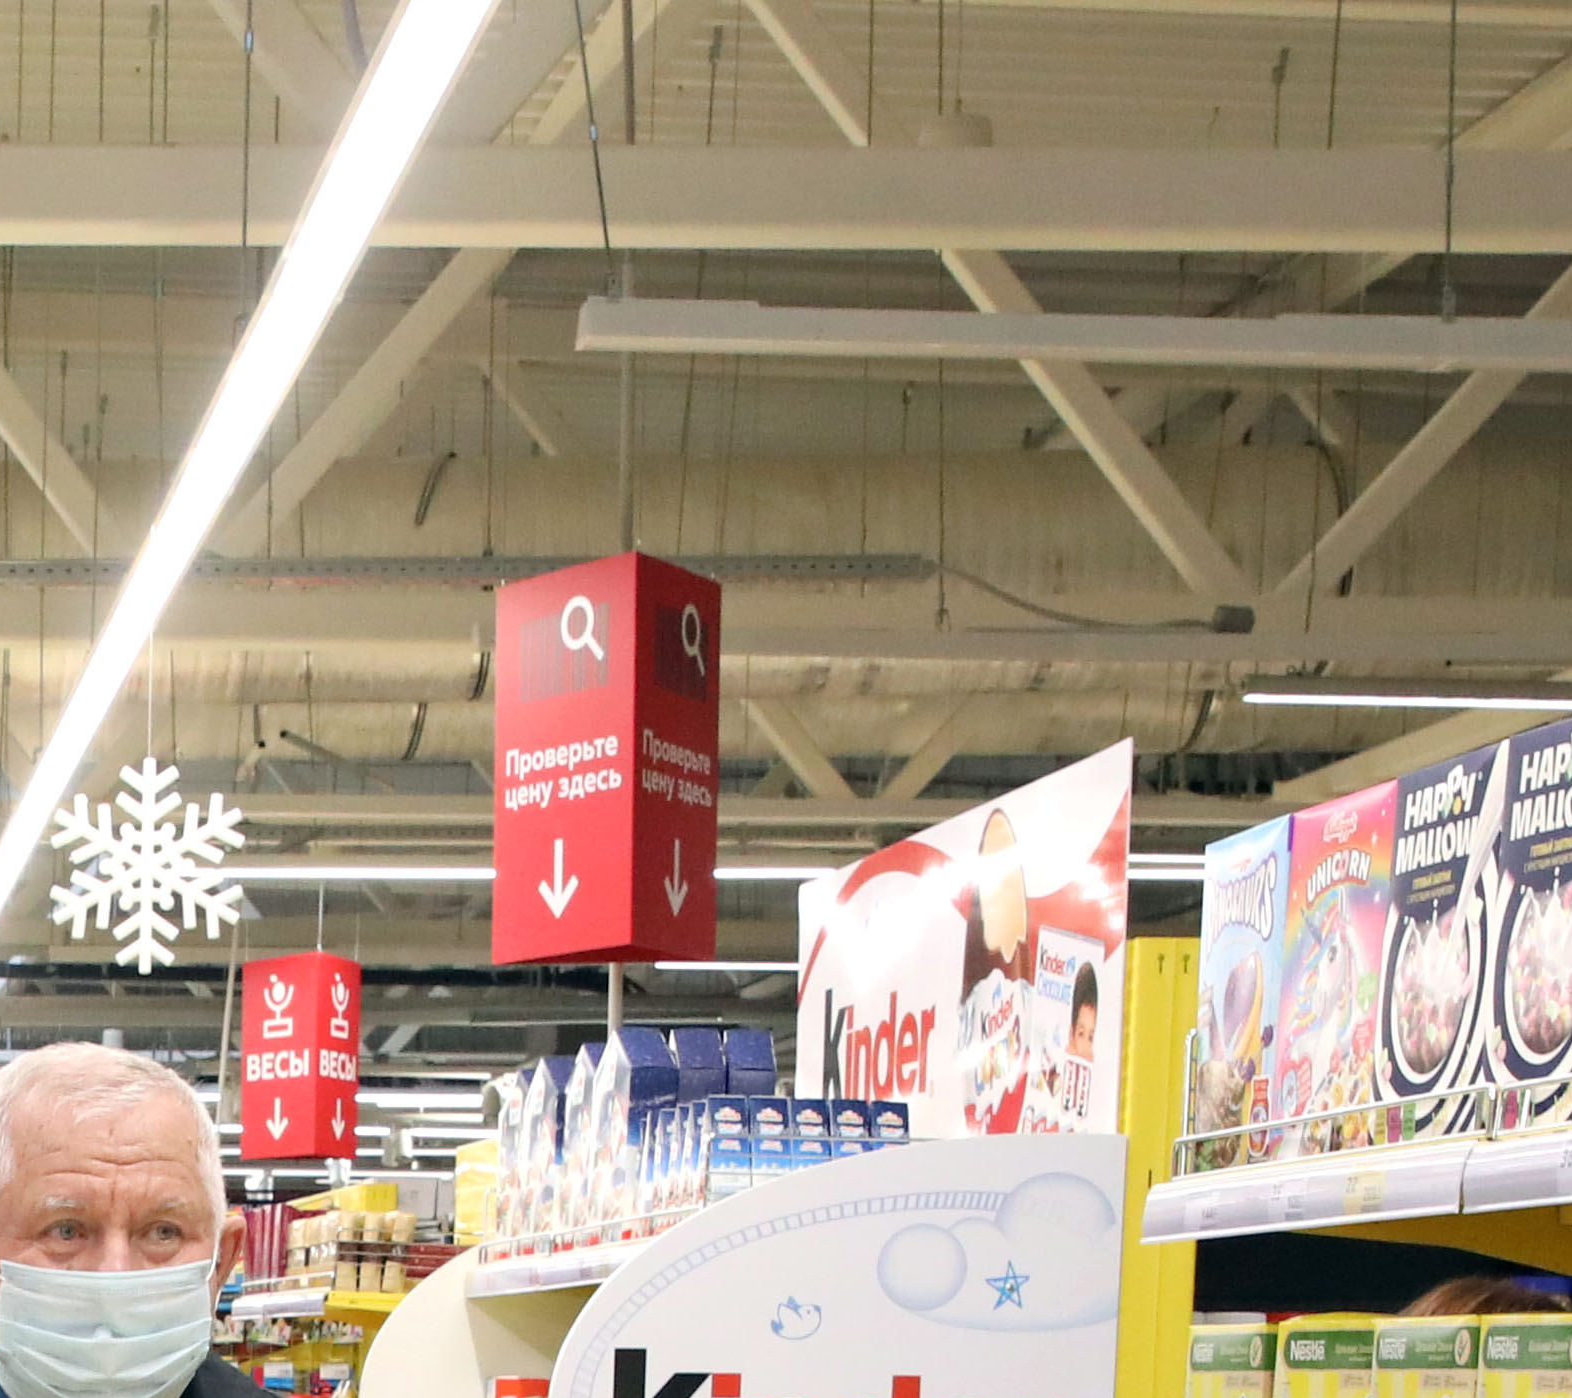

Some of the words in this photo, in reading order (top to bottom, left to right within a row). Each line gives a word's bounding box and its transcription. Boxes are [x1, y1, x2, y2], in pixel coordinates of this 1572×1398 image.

[505, 735, 619, 779] Проверьте
[642, 728, 711, 776] Проверьте
[505, 780, 553, 811] цену
[557, 769, 622, 800] здесь
[642, 768, 674, 800] цену
[678, 779, 712, 807] здесь
[1404, 762, 1478, 831] HAPPY
[1306, 848, 1371, 901] UNICORN
[246, 1048, 310, 1082] ВЕСЫ
[319, 1049, 356, 1082] ВЕСЫ
[823, 988, 936, 1101] Kinder
